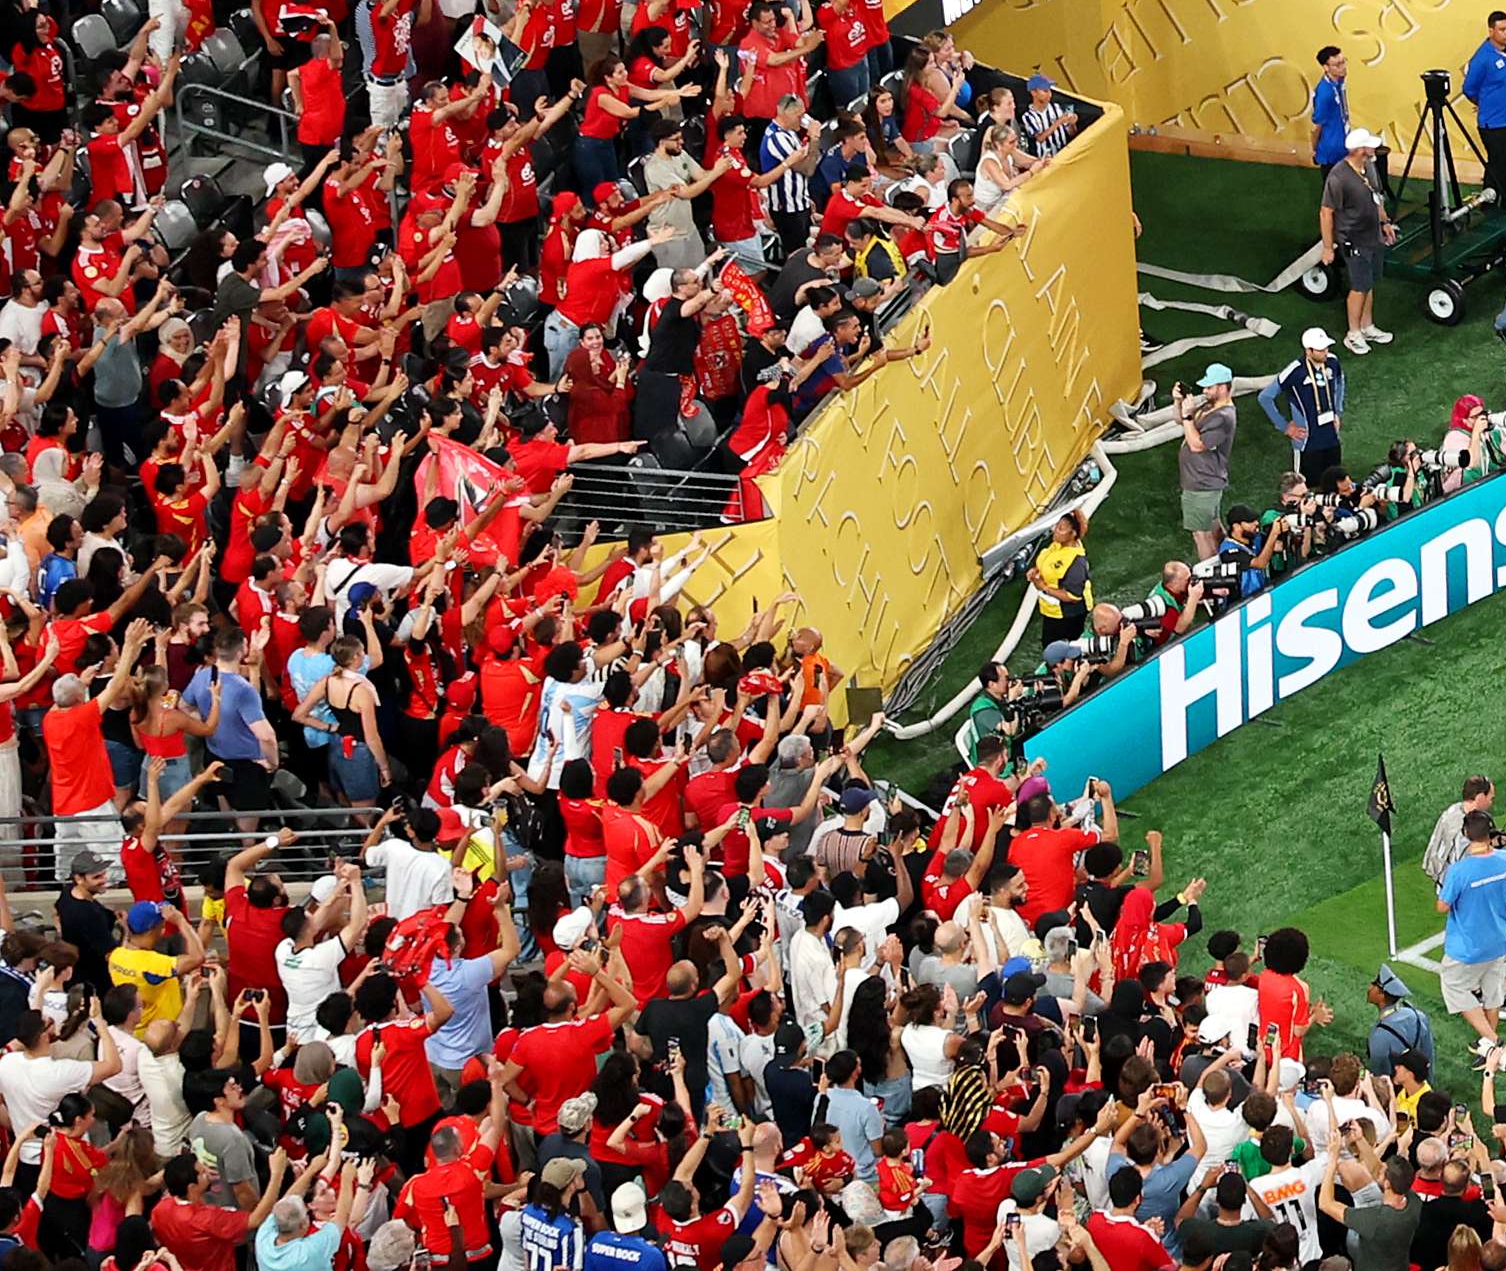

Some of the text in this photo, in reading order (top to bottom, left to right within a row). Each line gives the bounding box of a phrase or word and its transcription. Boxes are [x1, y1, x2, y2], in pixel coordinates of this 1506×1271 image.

[1263, 1180, 1306, 1204] BMG
[1275, 1198, 1308, 1231] 11
[591, 1242, 642, 1263] SUPER BOCK
